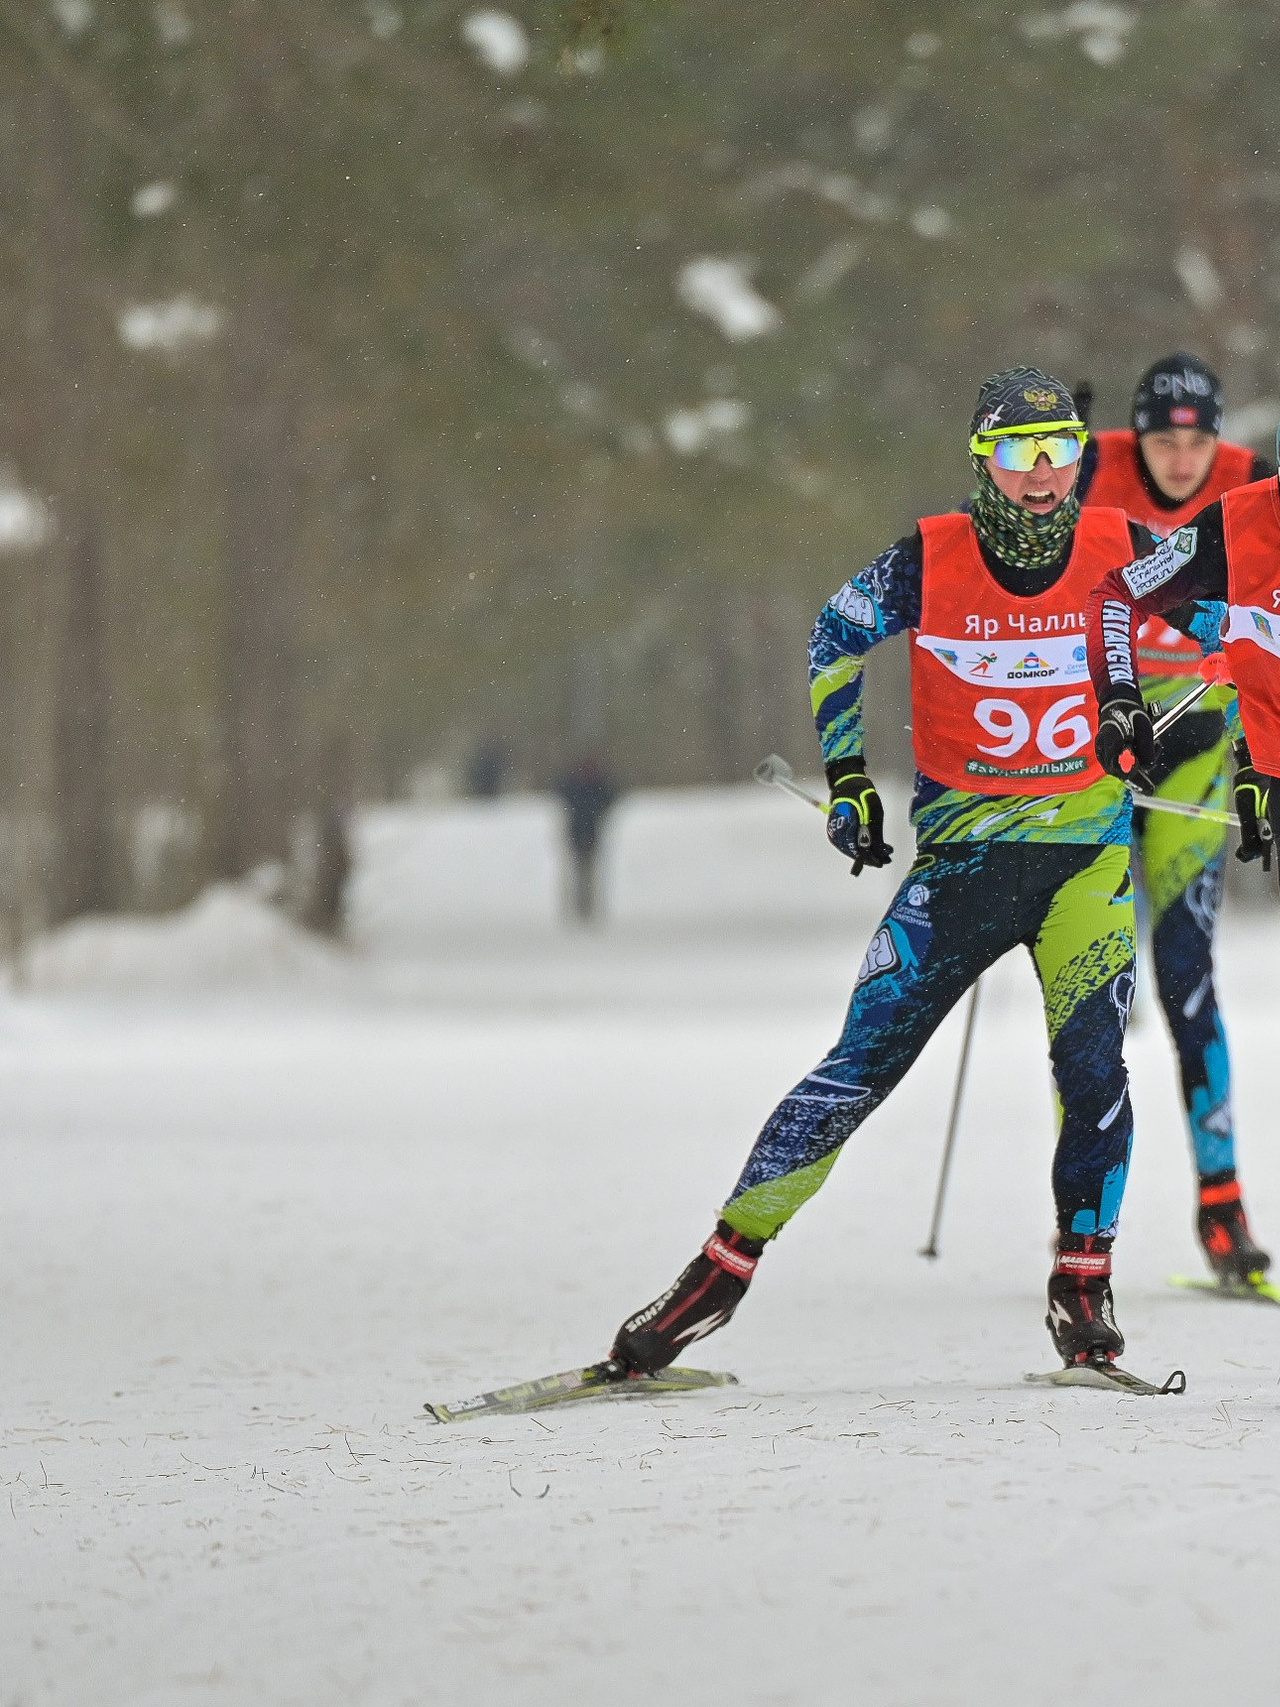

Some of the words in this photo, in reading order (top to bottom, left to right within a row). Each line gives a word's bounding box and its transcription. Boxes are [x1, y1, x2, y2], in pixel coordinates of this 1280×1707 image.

[965, 614, 999, 640] Яр
[1102, 600, 1137, 689] ТАТАРСТА
[973, 693, 1092, 760] 96
